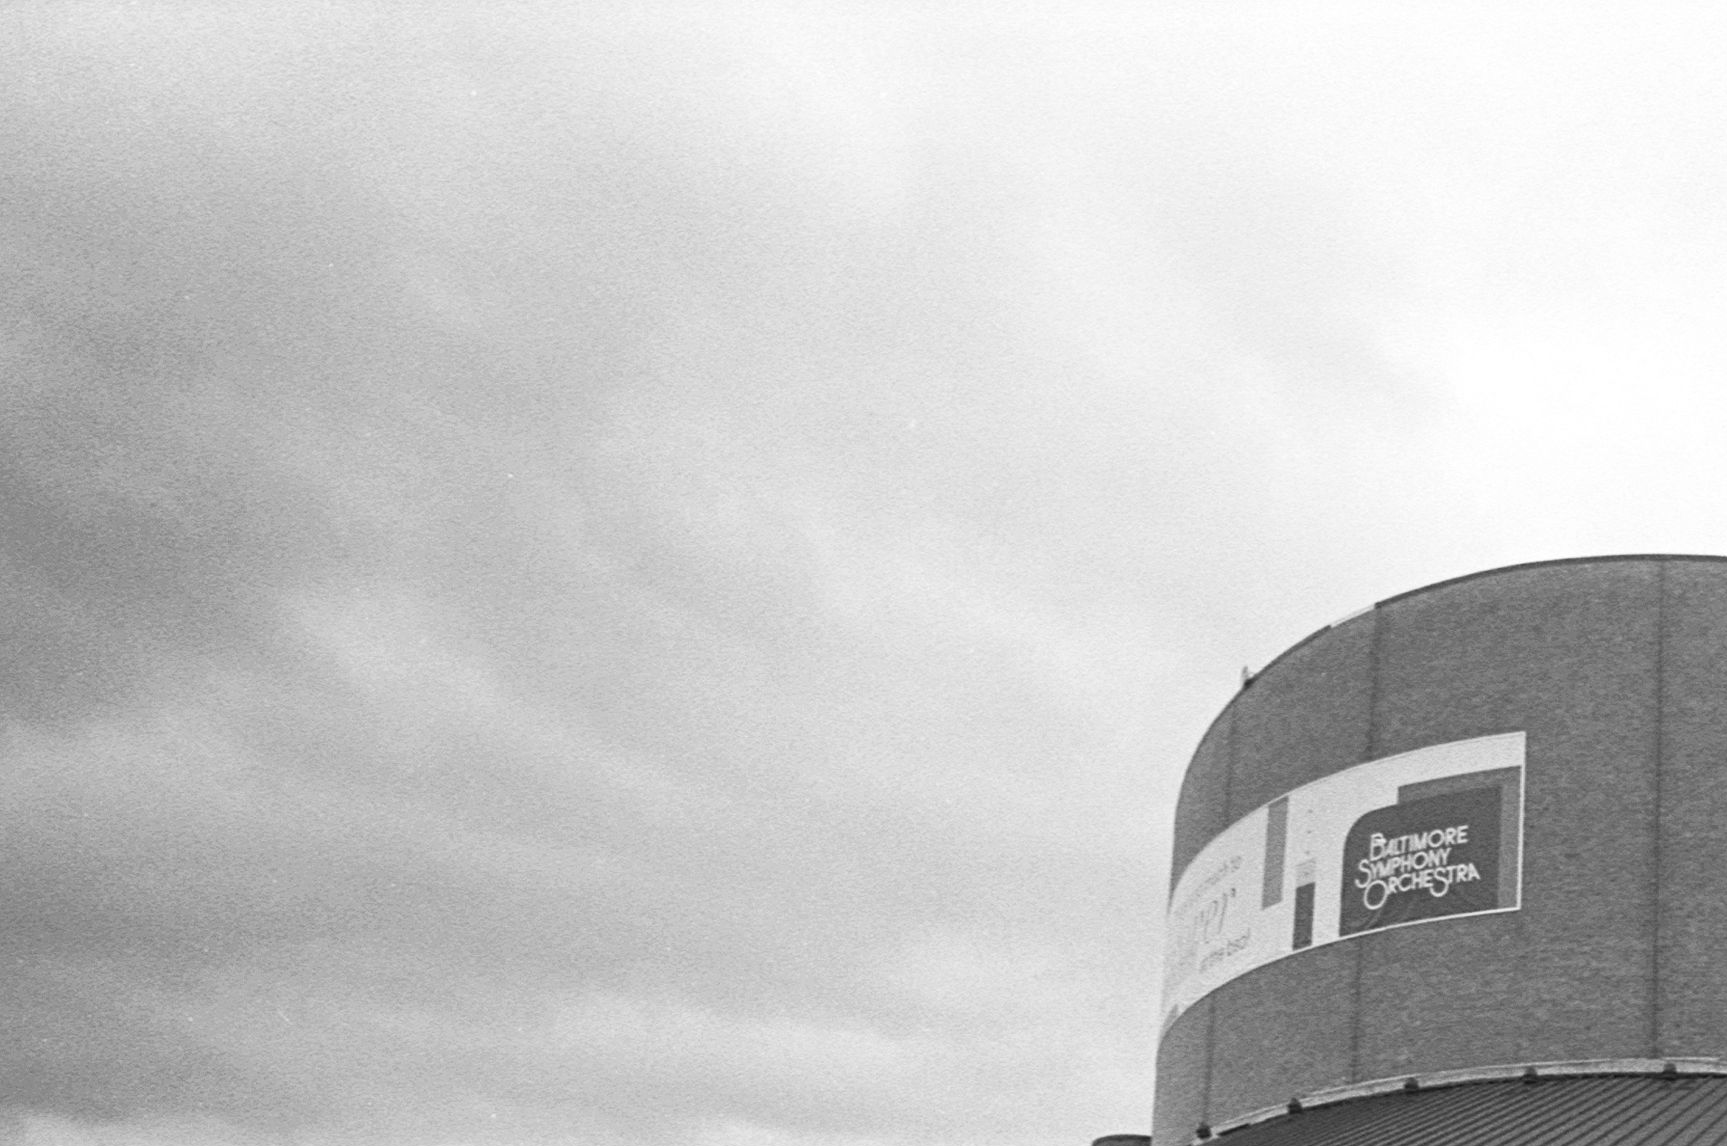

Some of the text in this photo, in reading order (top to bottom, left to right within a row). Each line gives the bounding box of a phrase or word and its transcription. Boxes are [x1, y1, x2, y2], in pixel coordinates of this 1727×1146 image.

[1369, 825, 1469, 861] BALTIMORE
[1354, 847, 1452, 889] SYMPHONY
[1363, 862, 1480, 910] ORCHESTRA
